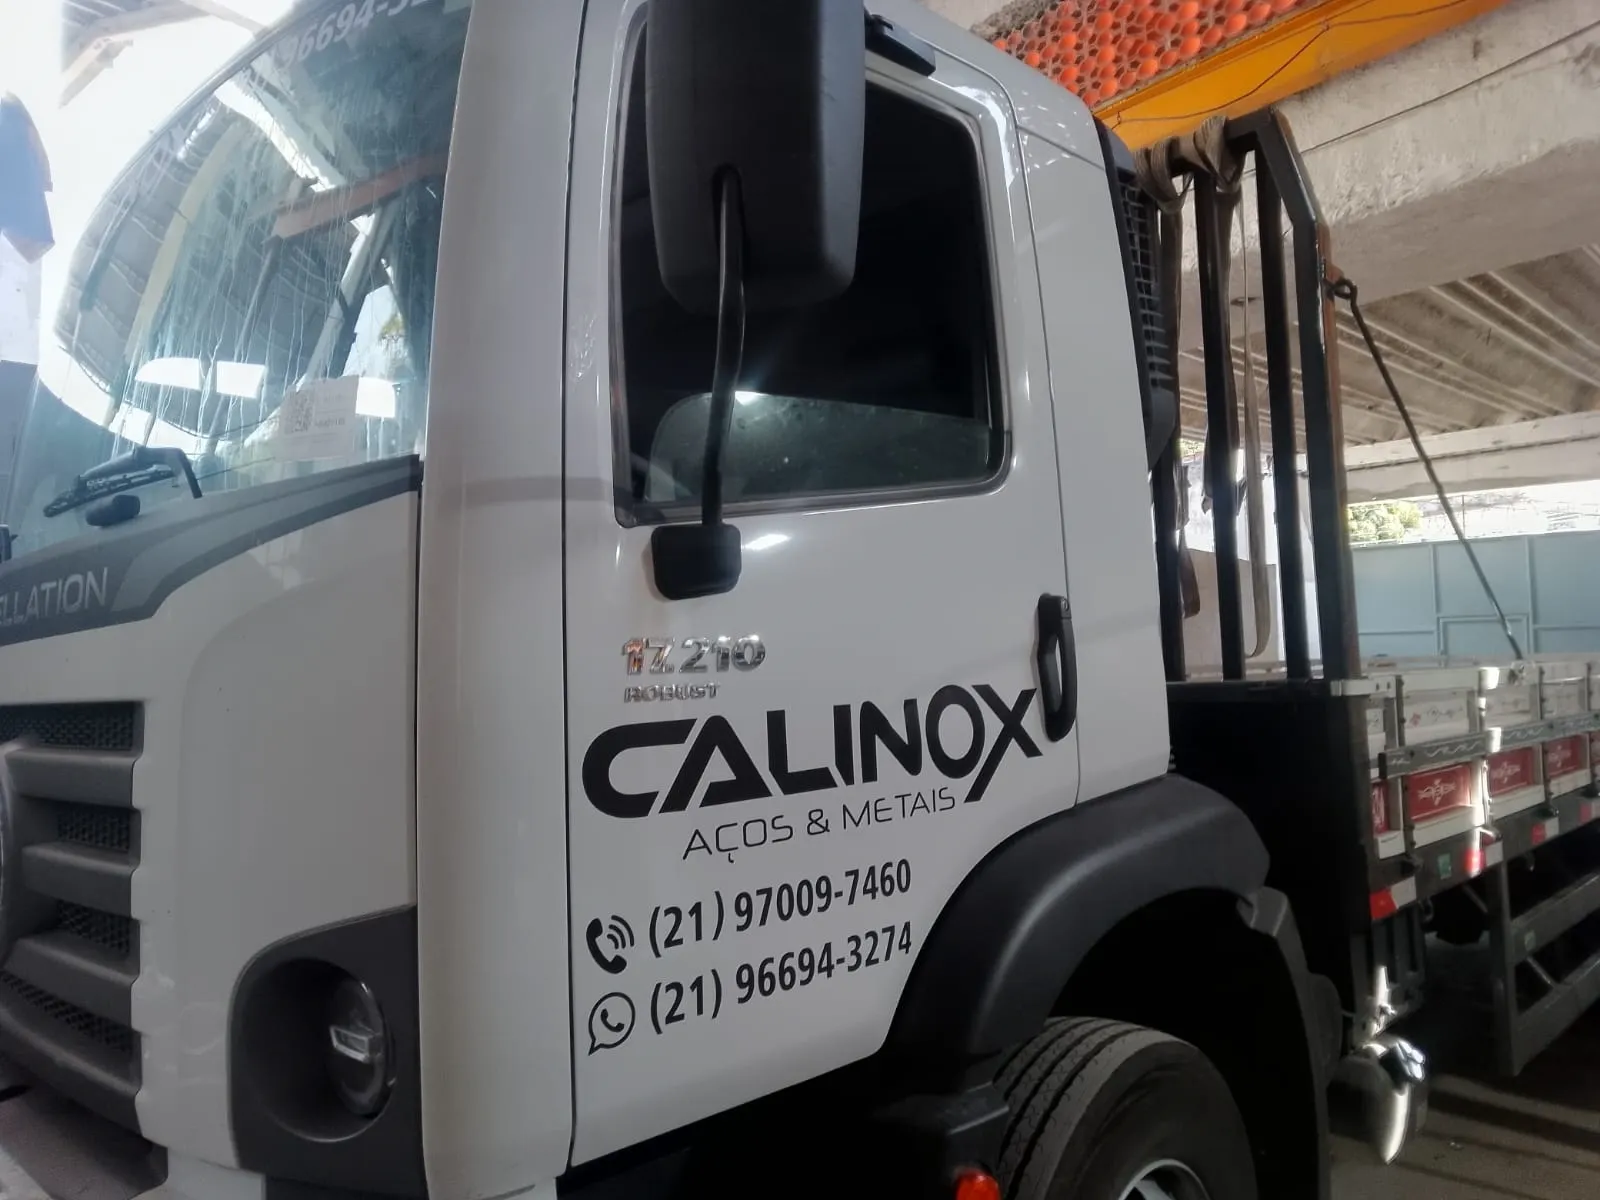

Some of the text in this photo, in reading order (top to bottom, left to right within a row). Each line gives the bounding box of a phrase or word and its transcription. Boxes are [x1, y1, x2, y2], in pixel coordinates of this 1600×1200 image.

[623, 682, 721, 703] ROBUST
[582, 684, 1043, 818] CALINOX
[683, 787, 955, 863] AÇOS & METAIS
[649, 859, 911, 958] (21) 97009-7460
[651, 921, 911, 1034] (21) 96694-3274
